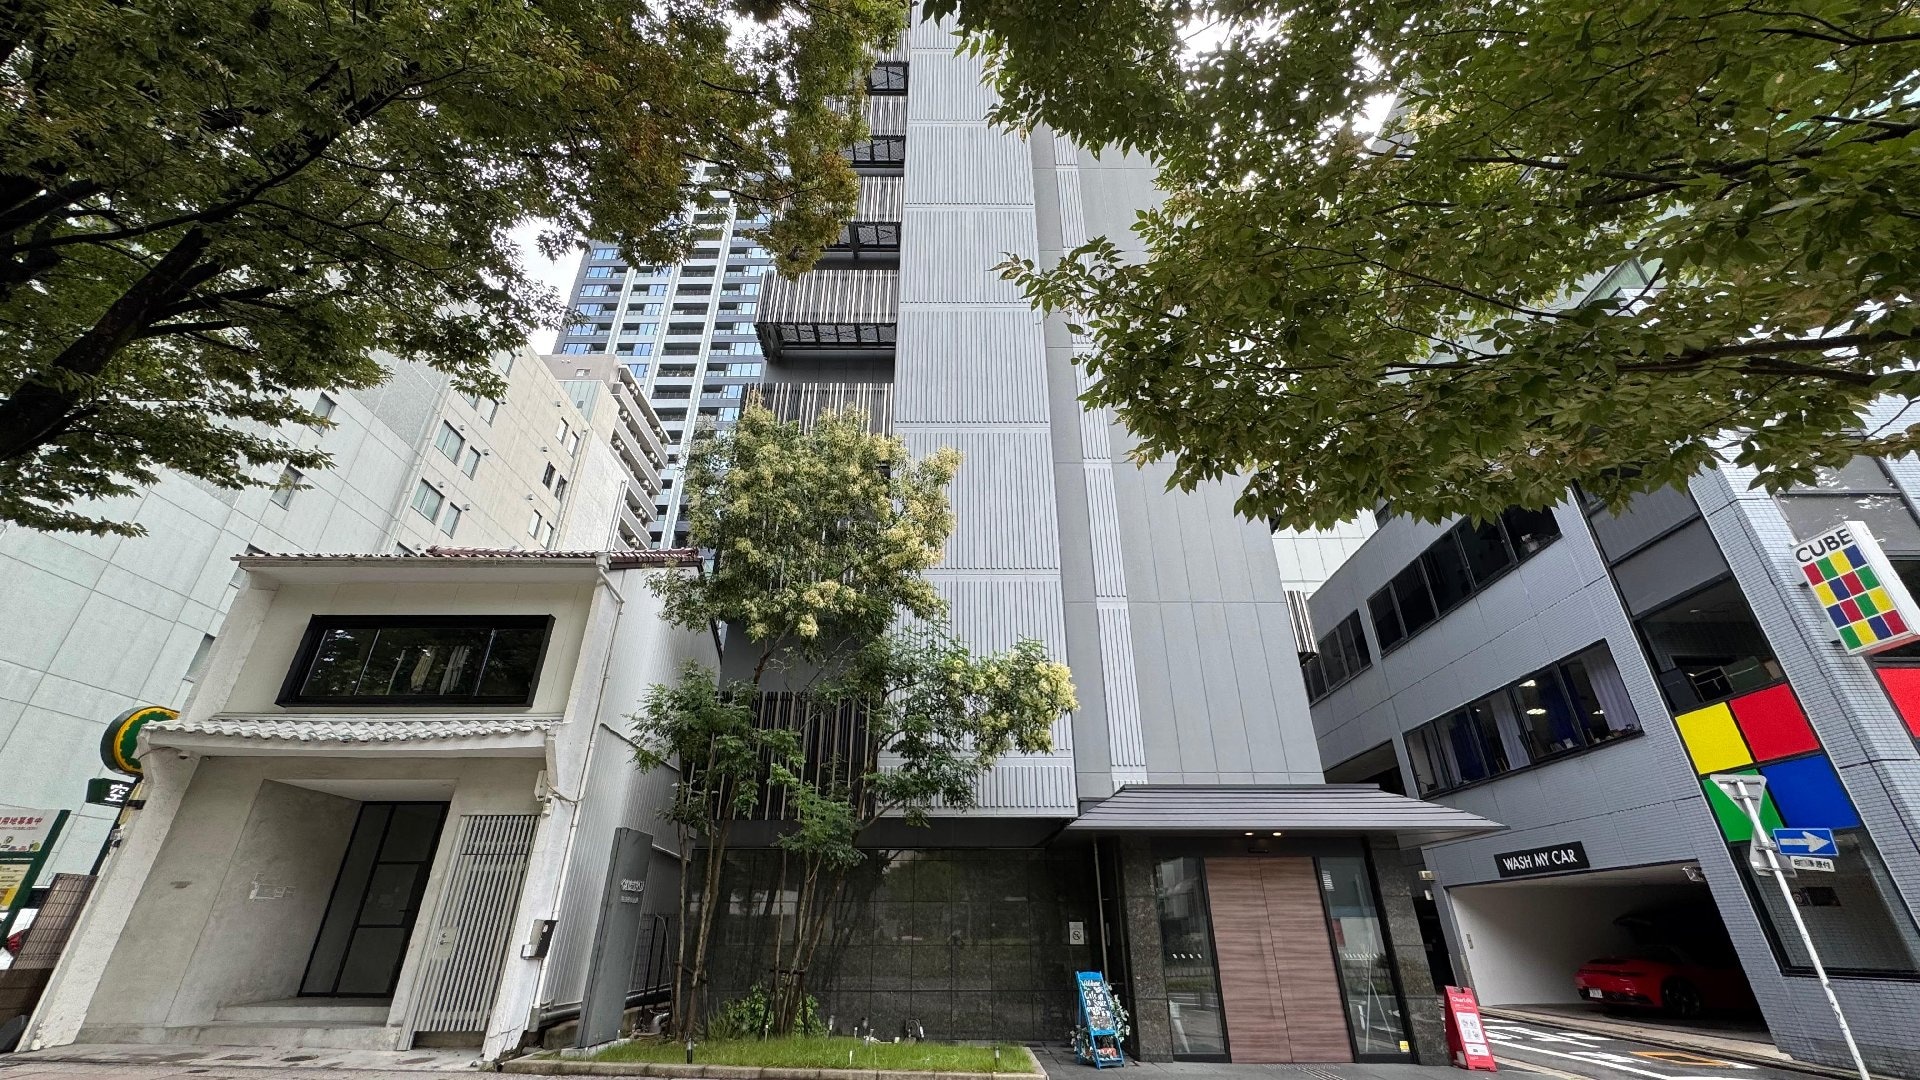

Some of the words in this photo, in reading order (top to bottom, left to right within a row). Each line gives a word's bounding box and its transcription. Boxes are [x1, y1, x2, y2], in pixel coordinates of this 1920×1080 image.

[1795, 528, 1854, 563] CUBE
[0, 817, 42, 825] 用地募集中
[1503, 855, 1533, 871] WASH
[1534, 852, 1550, 867] MY
[1551, 849, 1577, 864] CAR
